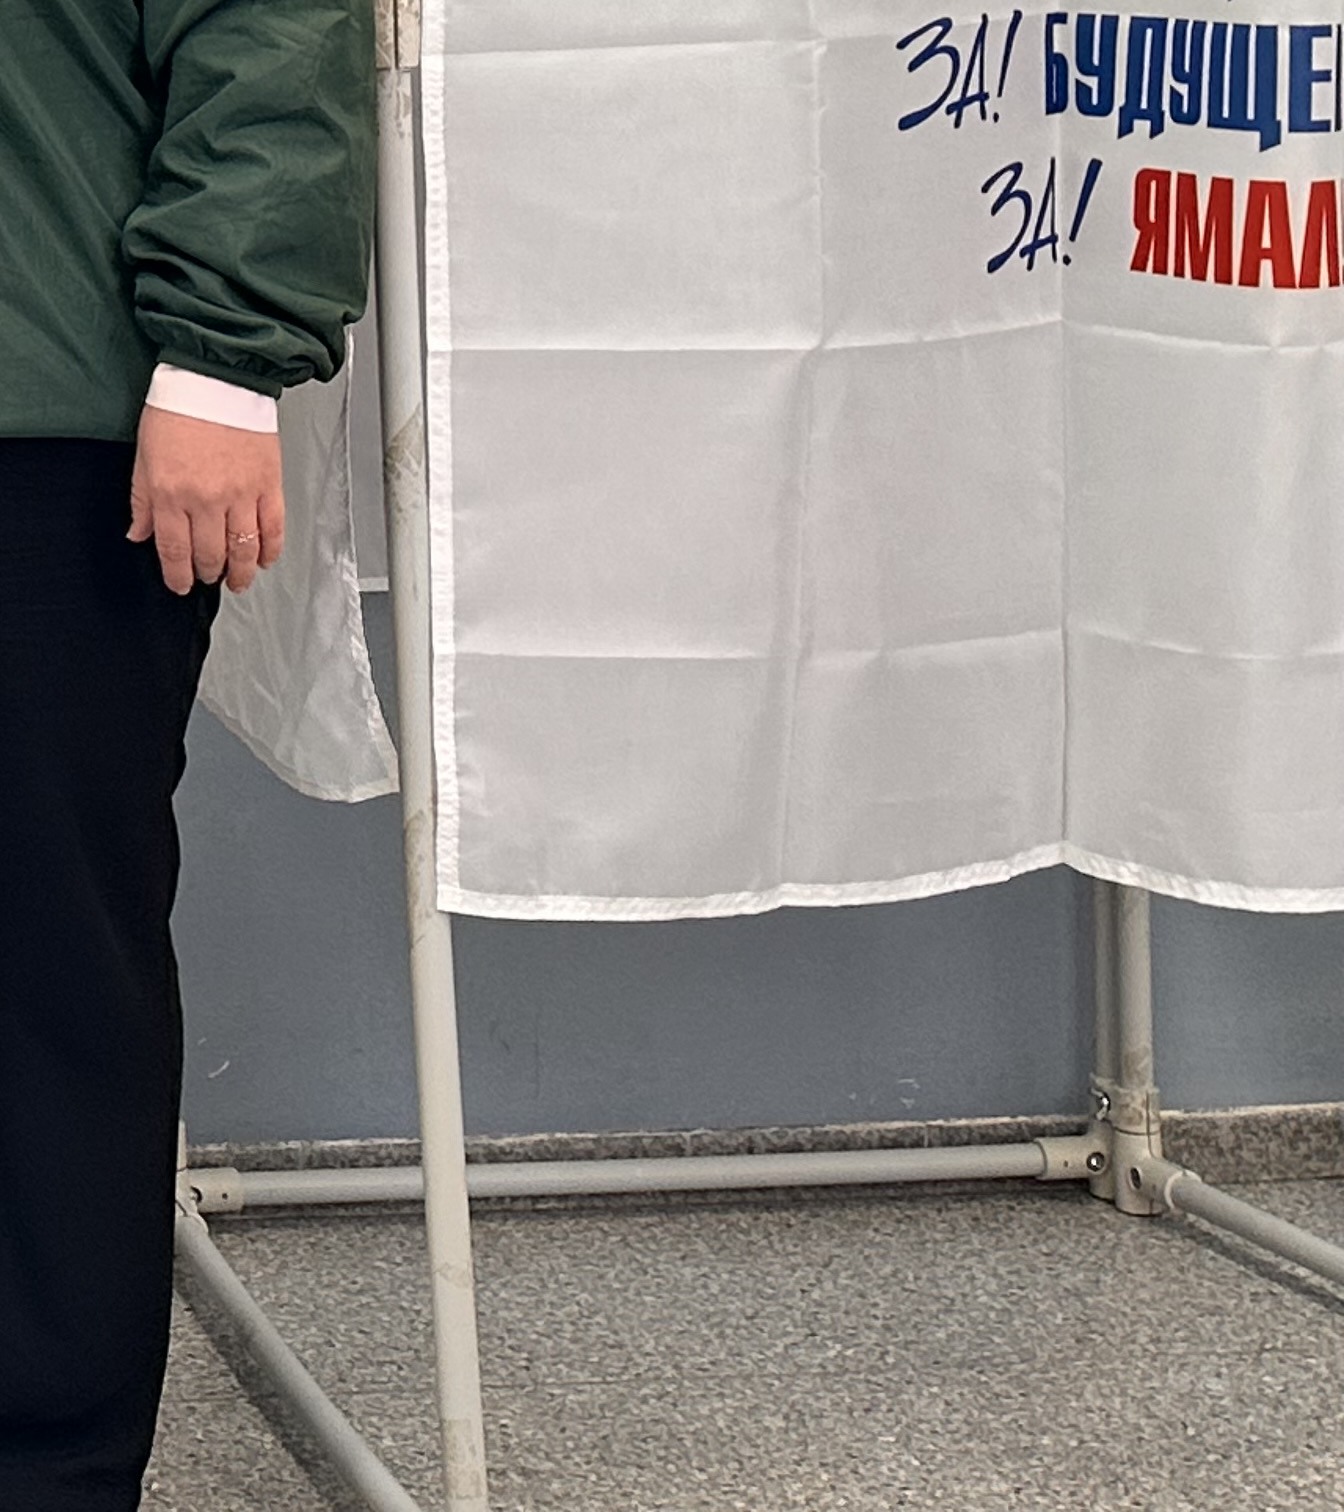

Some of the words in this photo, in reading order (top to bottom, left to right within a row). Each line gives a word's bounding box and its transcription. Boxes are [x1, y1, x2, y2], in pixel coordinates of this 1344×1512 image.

[896, 10, 1022, 130] ЗА!
[1045, 13, 1342, 152] БУДУЩЕ
[981, 156, 1102, 274] ЗА!
[1130, 168, 1344, 289] ЯМАЛ
